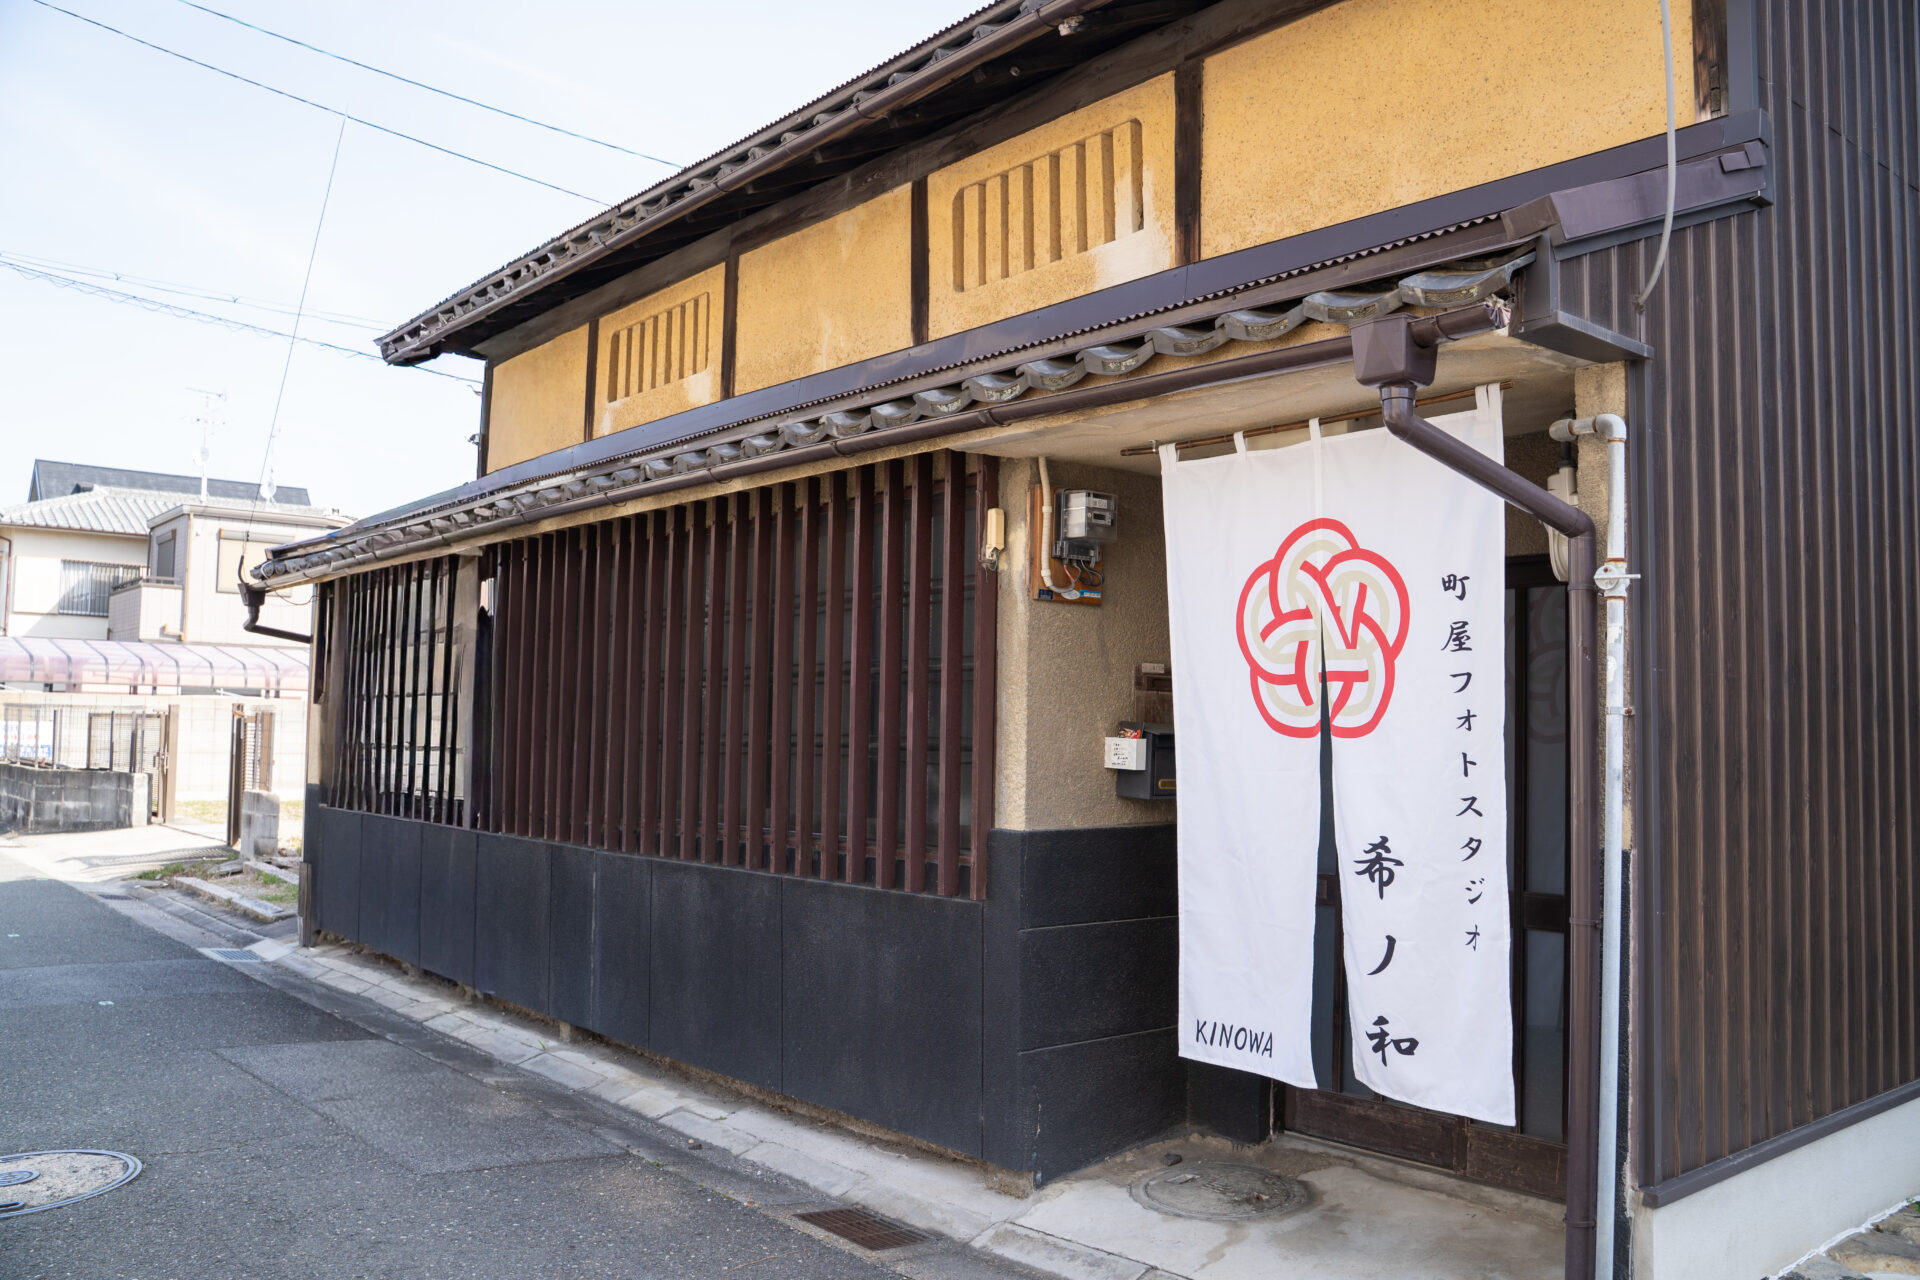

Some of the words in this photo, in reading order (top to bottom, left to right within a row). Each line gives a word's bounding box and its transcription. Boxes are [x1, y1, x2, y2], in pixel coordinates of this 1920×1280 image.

[1353, 835, 1420, 1067] 希ノ和
[1196, 1020, 1273, 1058] KINOWA
